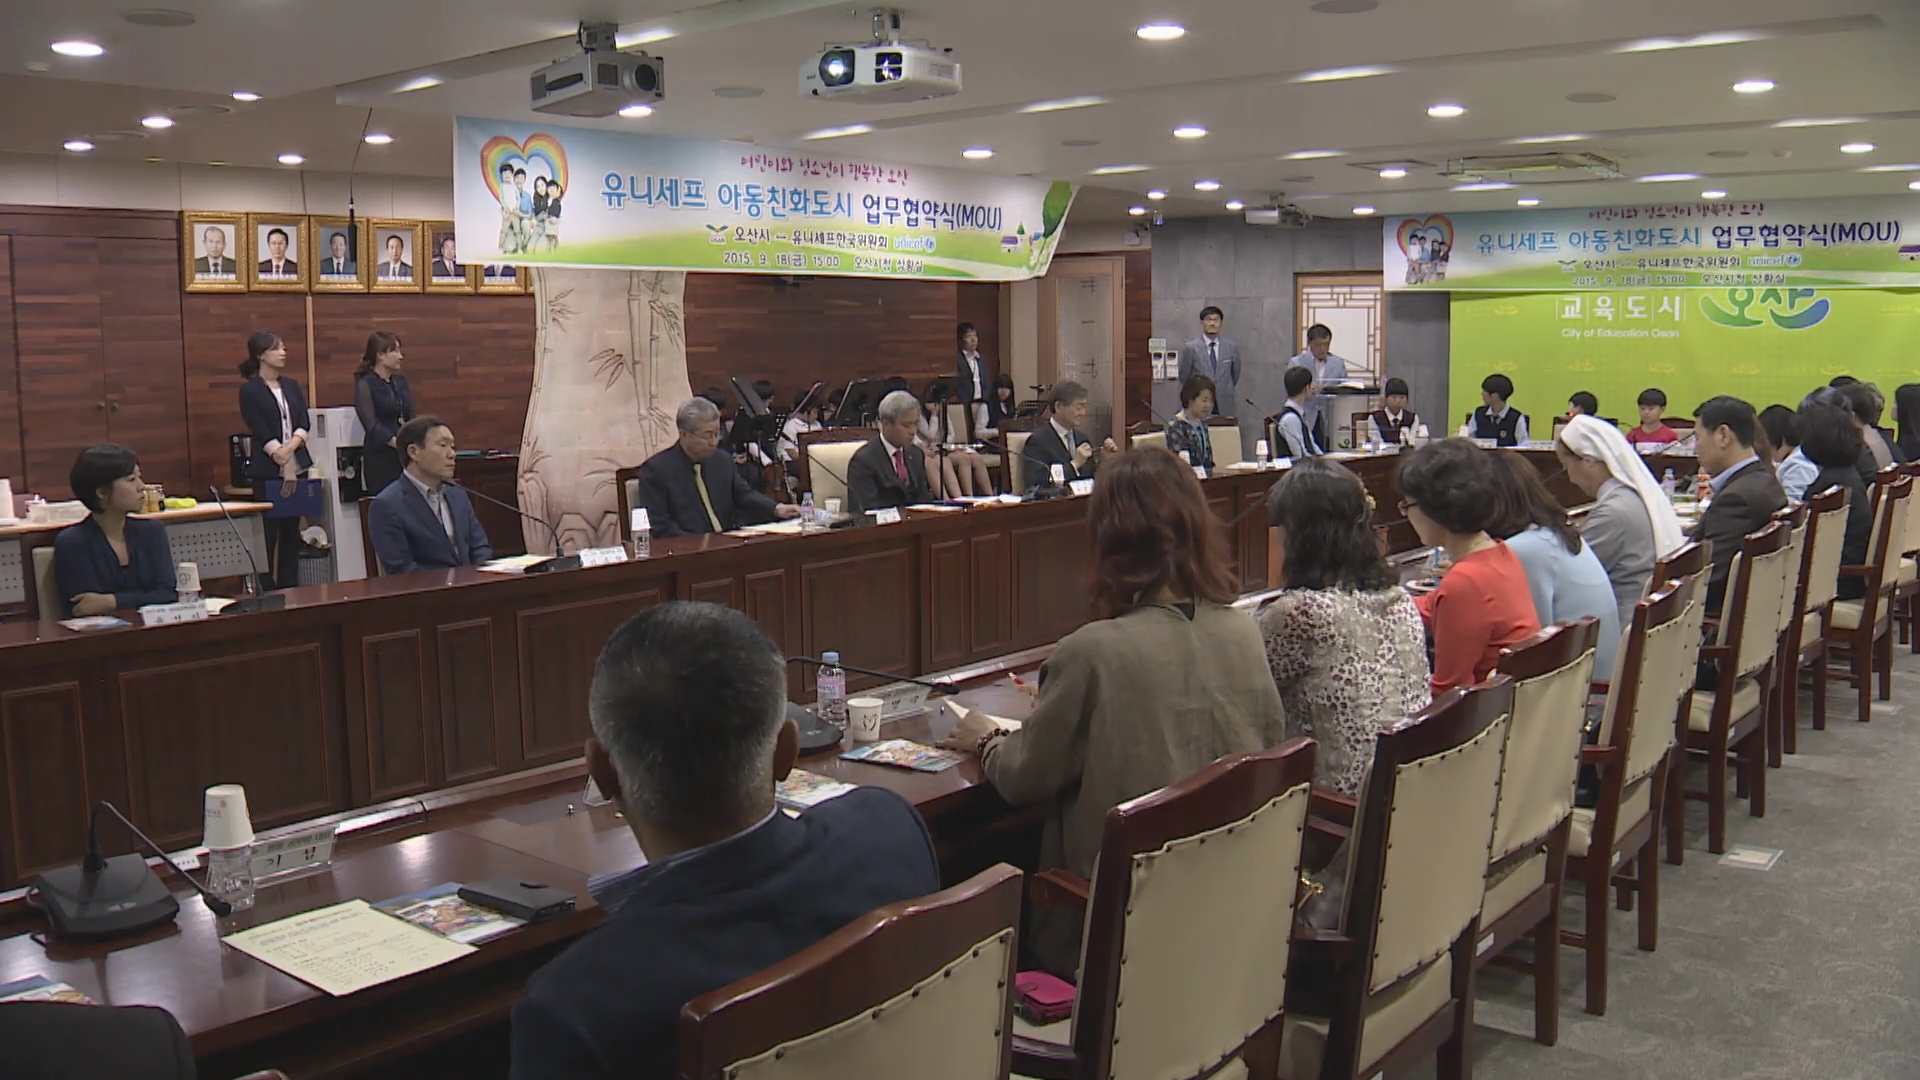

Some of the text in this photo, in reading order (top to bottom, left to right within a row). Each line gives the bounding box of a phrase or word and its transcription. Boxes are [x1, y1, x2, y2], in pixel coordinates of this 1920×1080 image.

[601, 172, 1002, 231] 유니세프 아동친화도시 업무협약식(MOU)
[734, 226, 770, 244] 오산시
[792, 229, 888, 250] 유니세프한국위원회
[1477, 219, 1900, 255] 유니세프 아동친화도시 업무협약식(MOU)
[723, 252, 753, 266] 2015.
[776, 254, 806, 268] 18(금)
[813, 256, 840, 268] 15:00
[1583, 258, 1615, 271] 오산시
[1560, 295, 1681, 322] 교육도시
[1561, 328, 1680, 340] City of Education Osan
